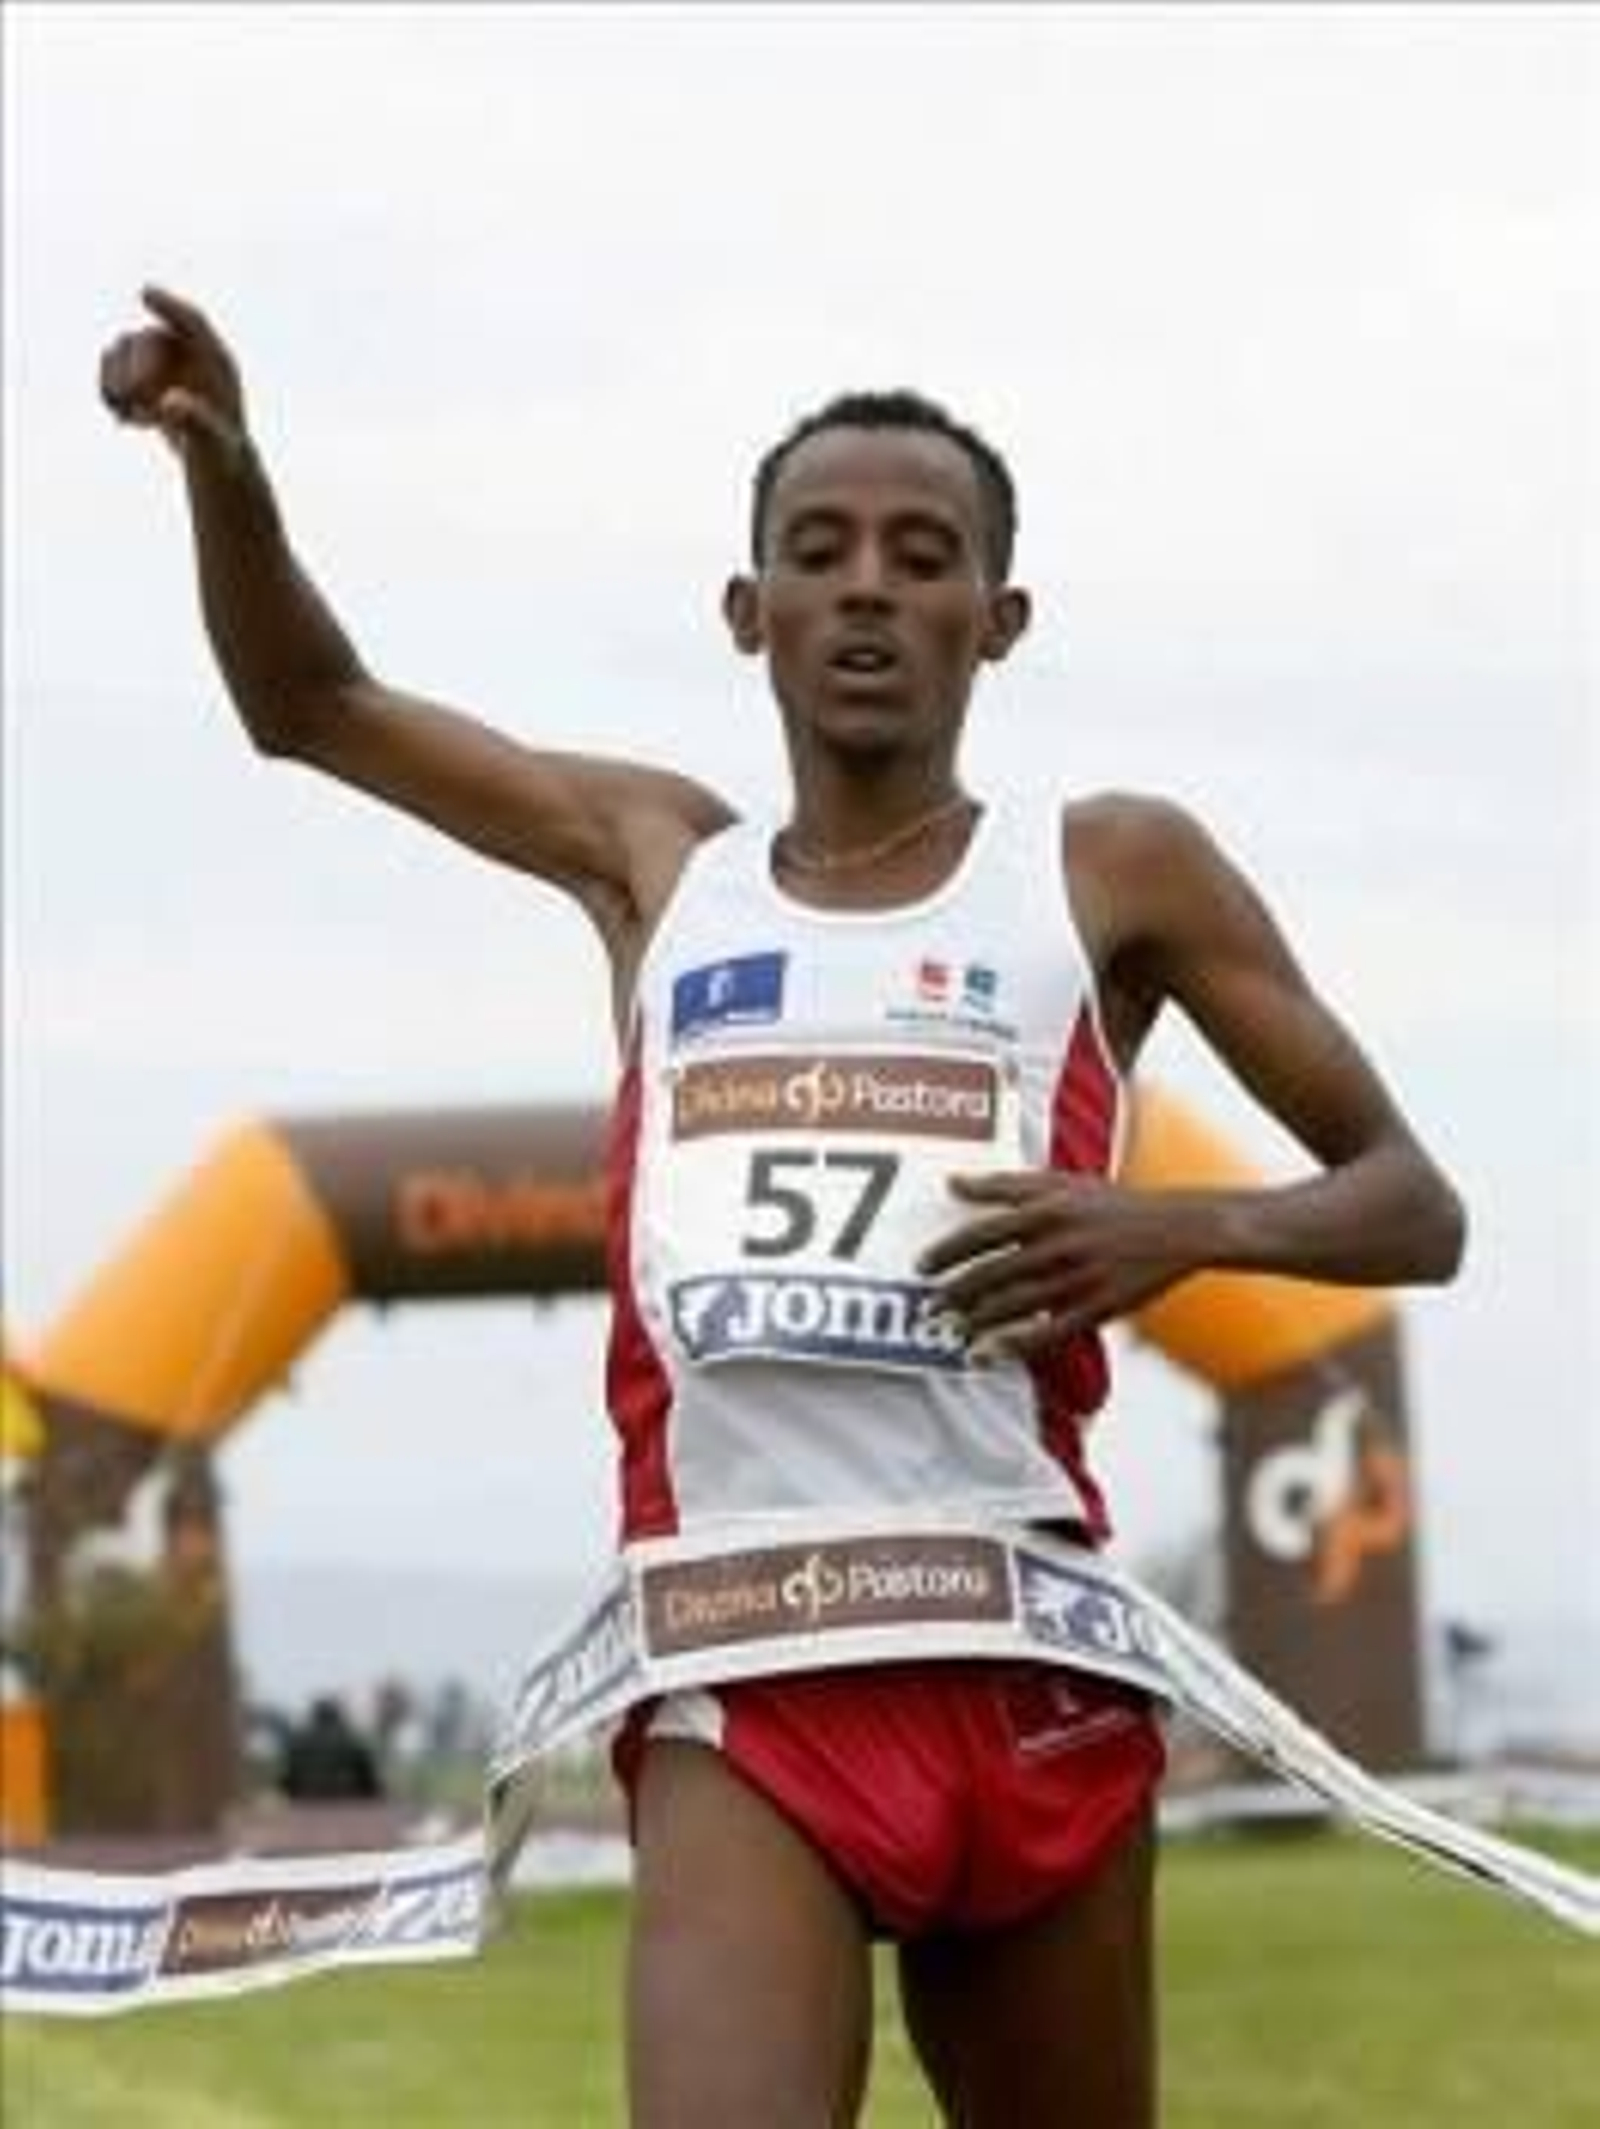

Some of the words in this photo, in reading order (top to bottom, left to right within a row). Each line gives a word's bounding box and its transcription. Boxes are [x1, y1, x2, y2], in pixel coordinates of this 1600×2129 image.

[853, 1074, 991, 1118] Pastora
[741, 1149, 901, 1262] 57
[849, 1560, 991, 1603] Pastora
